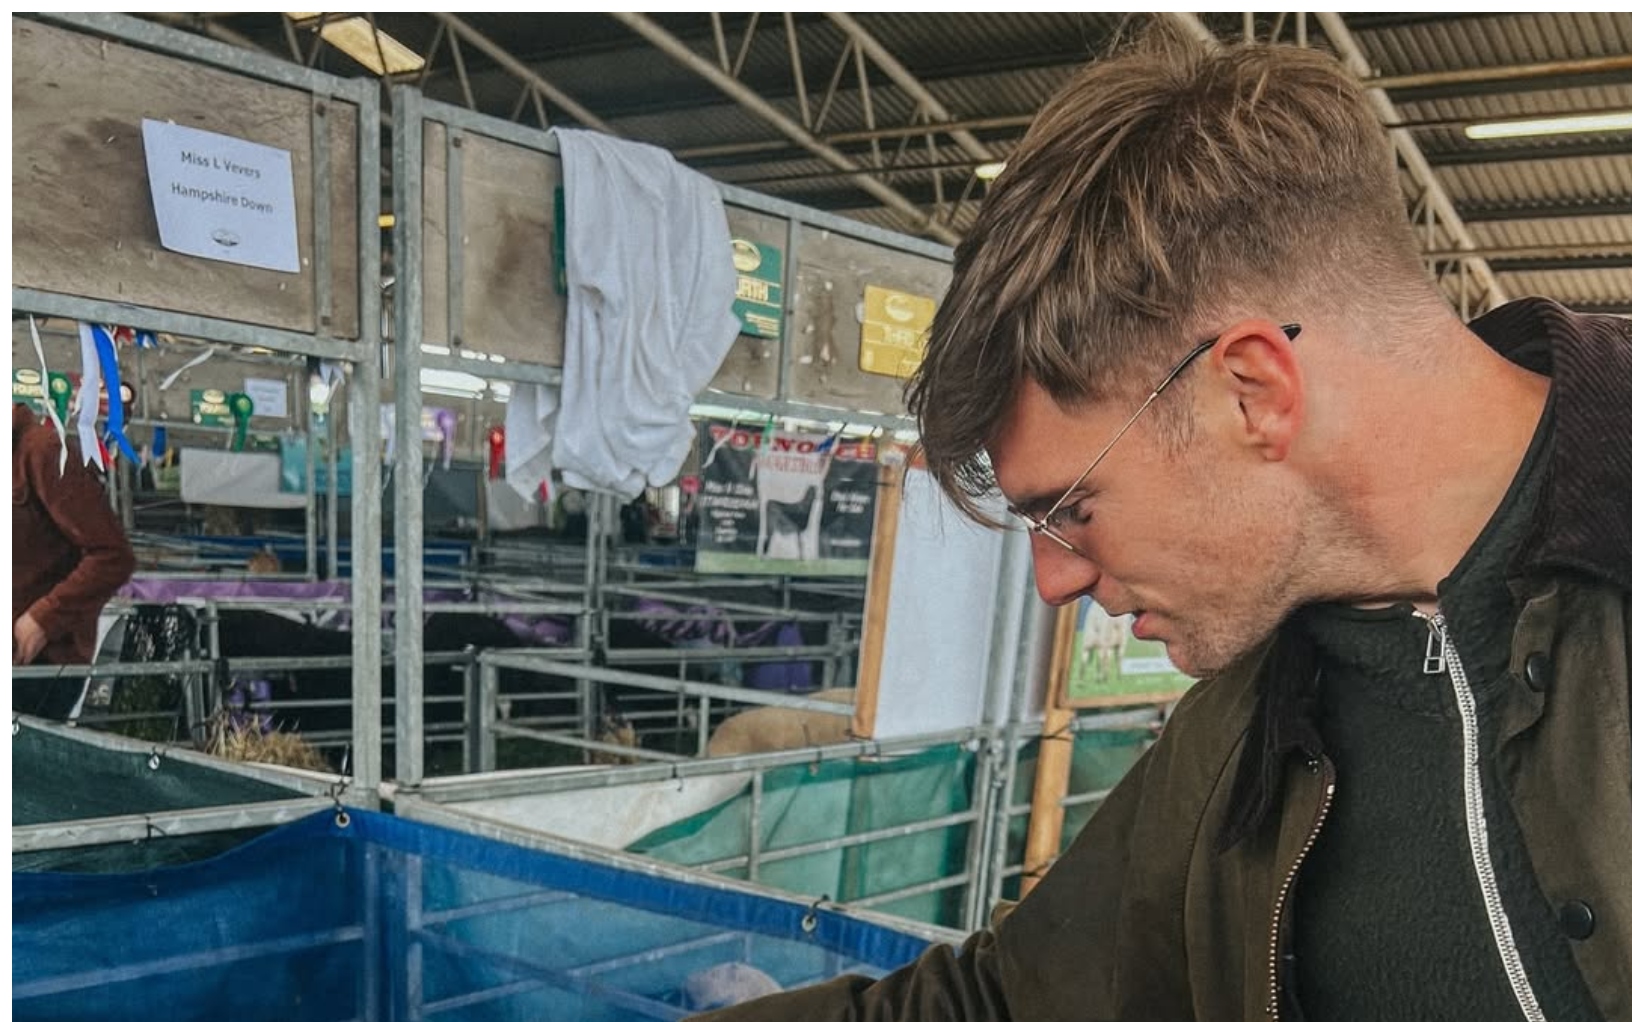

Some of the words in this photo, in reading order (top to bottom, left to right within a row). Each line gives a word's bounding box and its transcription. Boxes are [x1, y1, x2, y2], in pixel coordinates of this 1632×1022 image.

[181, 151, 210, 168] Miss
[213, 157, 221, 170] L
[223, 160, 262, 179] Vevers
[171, 182, 240, 207] Hampshire
[240, 197, 274, 214] Down
